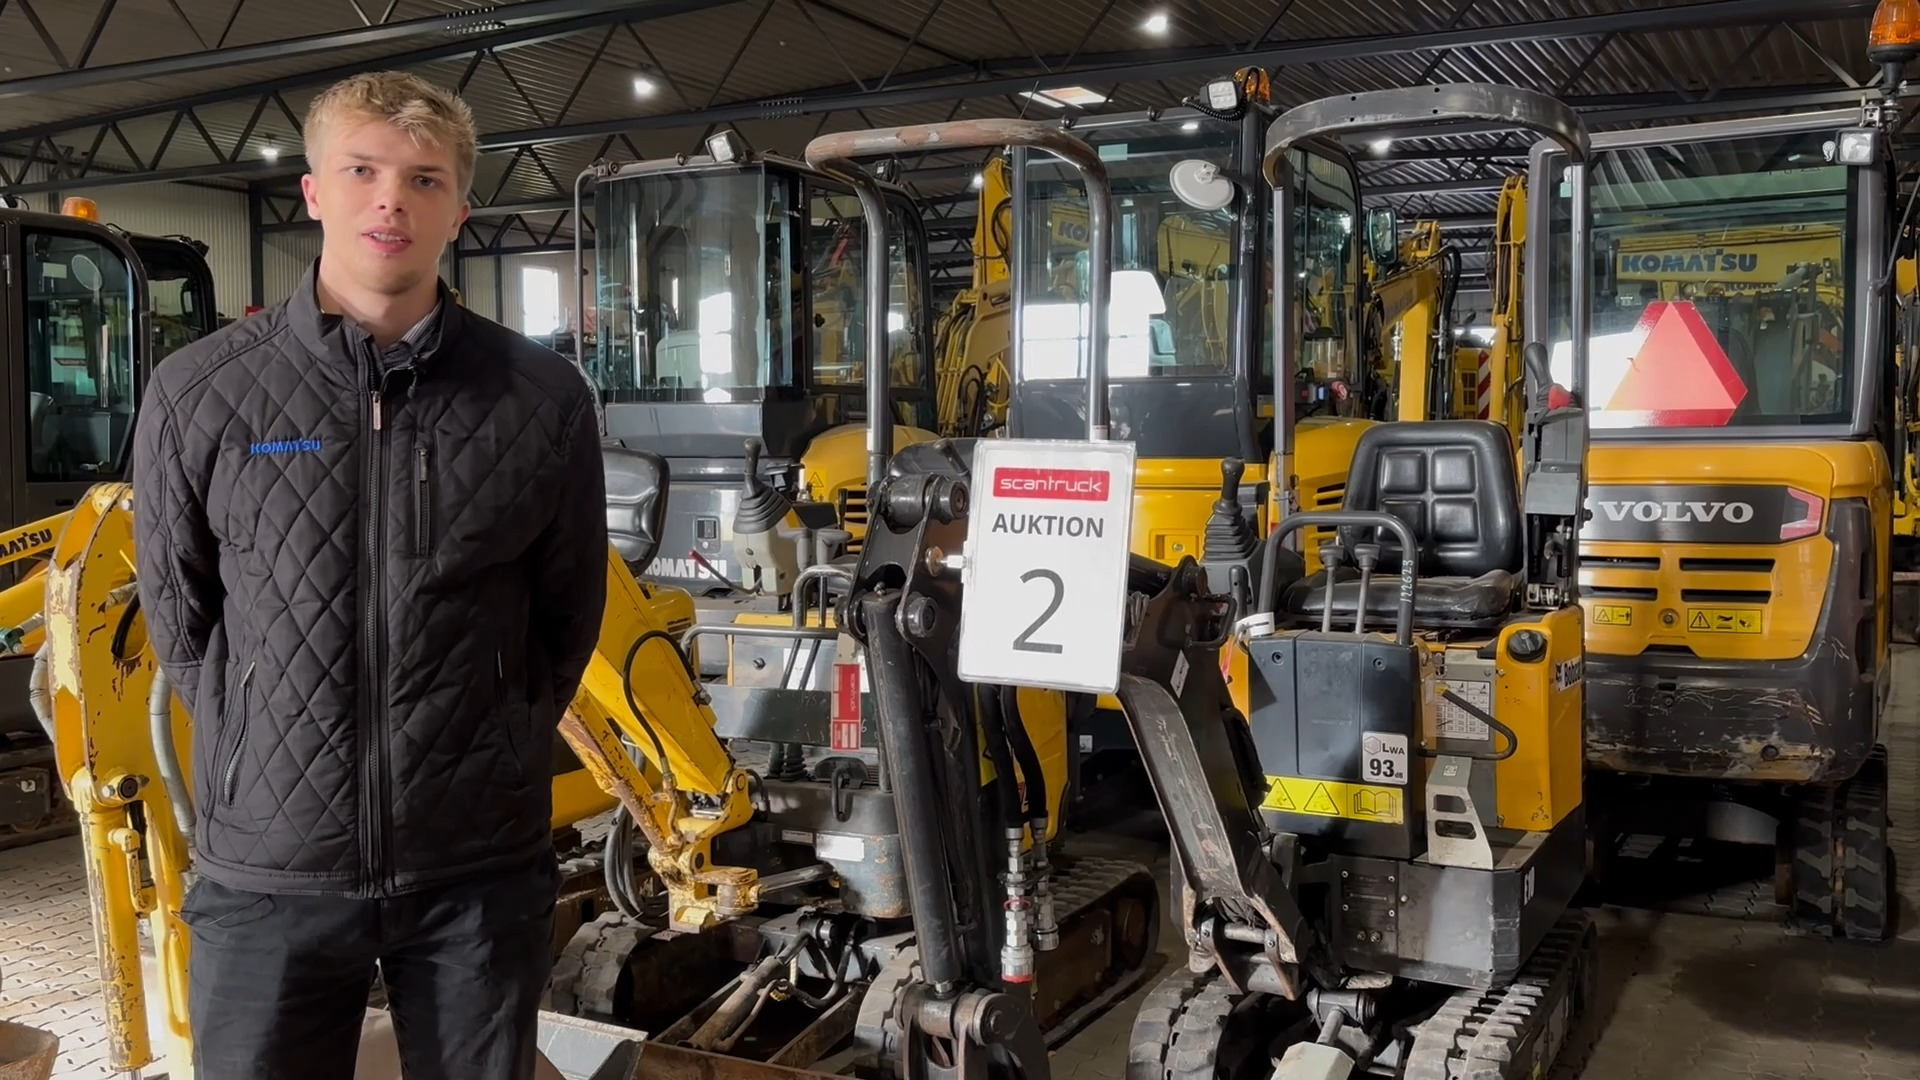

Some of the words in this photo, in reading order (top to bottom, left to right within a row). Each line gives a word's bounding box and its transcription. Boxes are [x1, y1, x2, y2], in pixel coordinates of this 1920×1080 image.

[1058, 222, 1090, 242] KO
[1621, 248, 1758, 273] KOMATSU
[250, 437, 322, 454] KOMATSU
[1000, 476, 1102, 493] scantruck
[1598, 500, 1754, 524] VOLVO
[991, 513, 1104, 538] AUKTION
[1011, 568, 1065, 654] 2
[1382, 743, 1406, 755] LWA
[1369, 758, 1395, 778] 93
